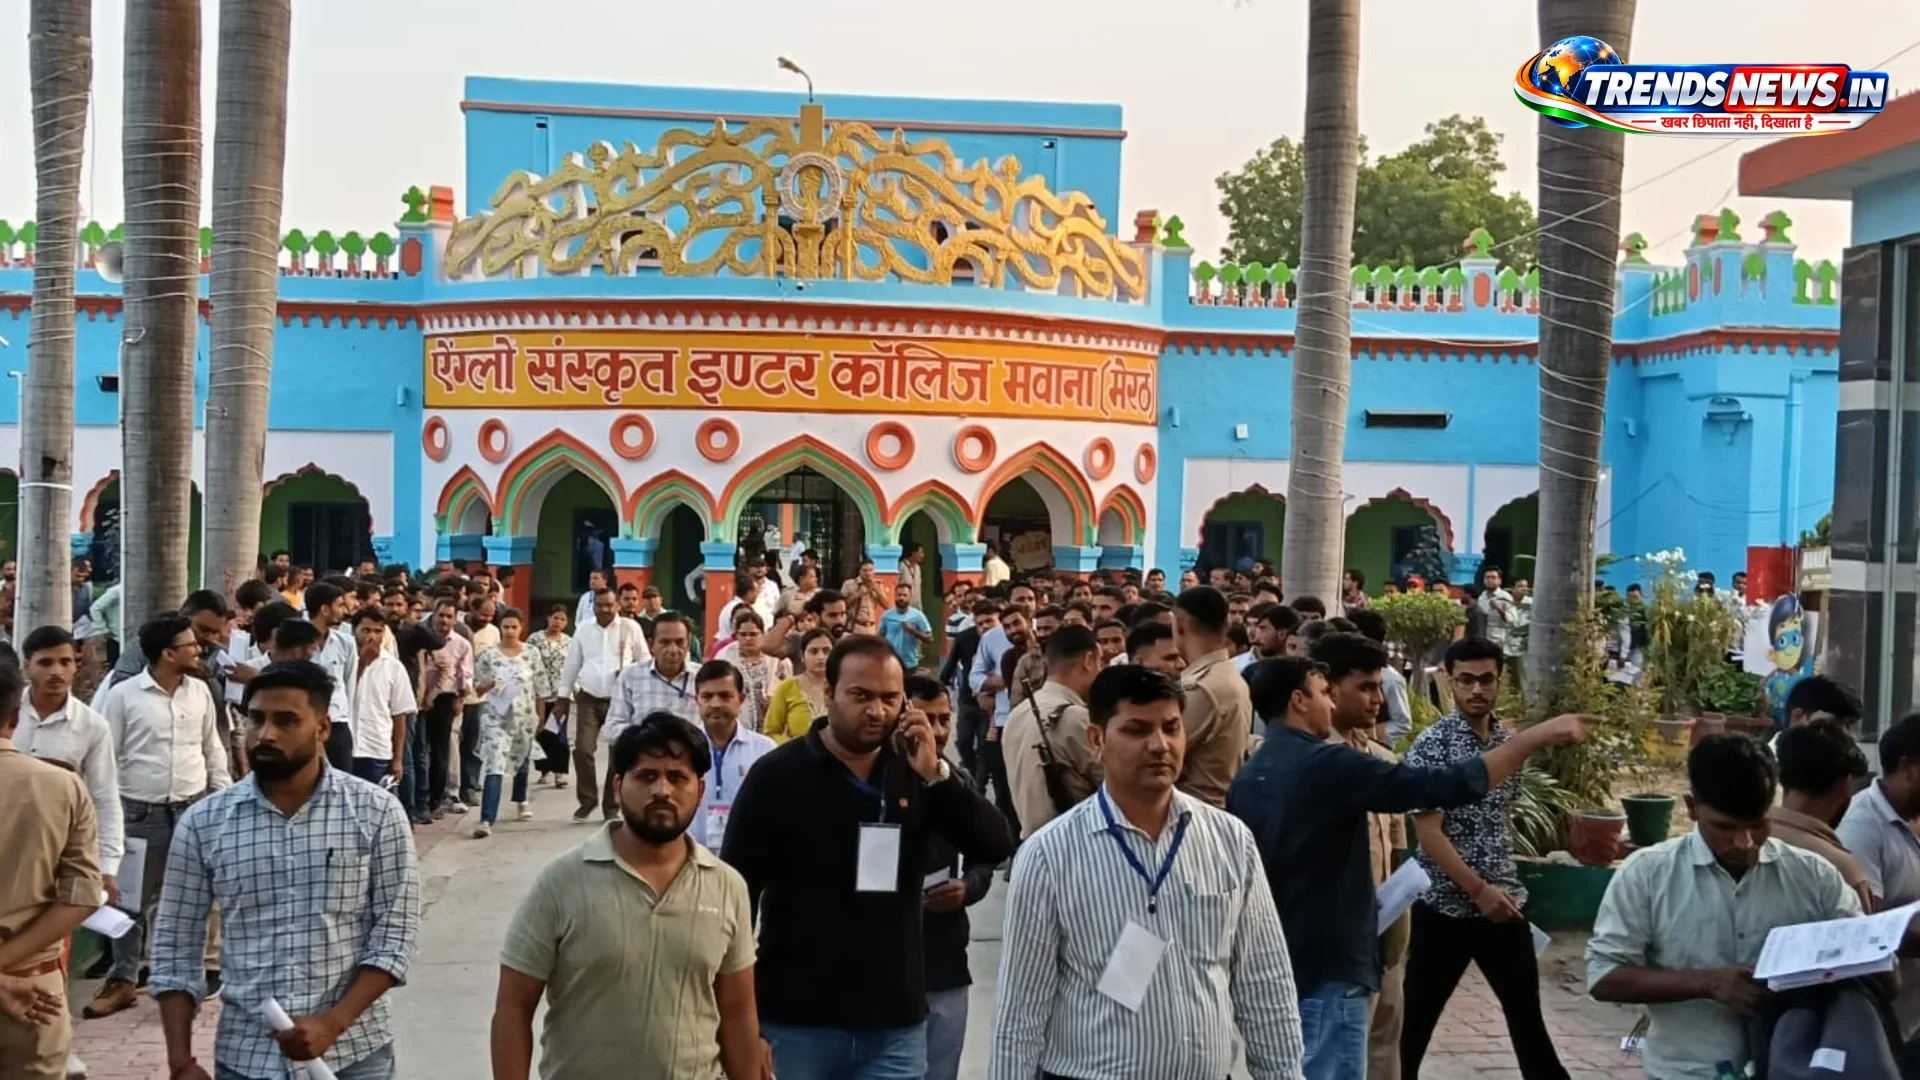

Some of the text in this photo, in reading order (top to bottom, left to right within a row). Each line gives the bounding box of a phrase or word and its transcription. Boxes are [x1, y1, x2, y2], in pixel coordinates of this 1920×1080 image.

[526, 336, 679, 402] संस्कृत
[687, 349, 821, 404] इण्टर
[831, 340, 994, 402] कॉलिज
[1002, 360, 1098, 408] मवाना
